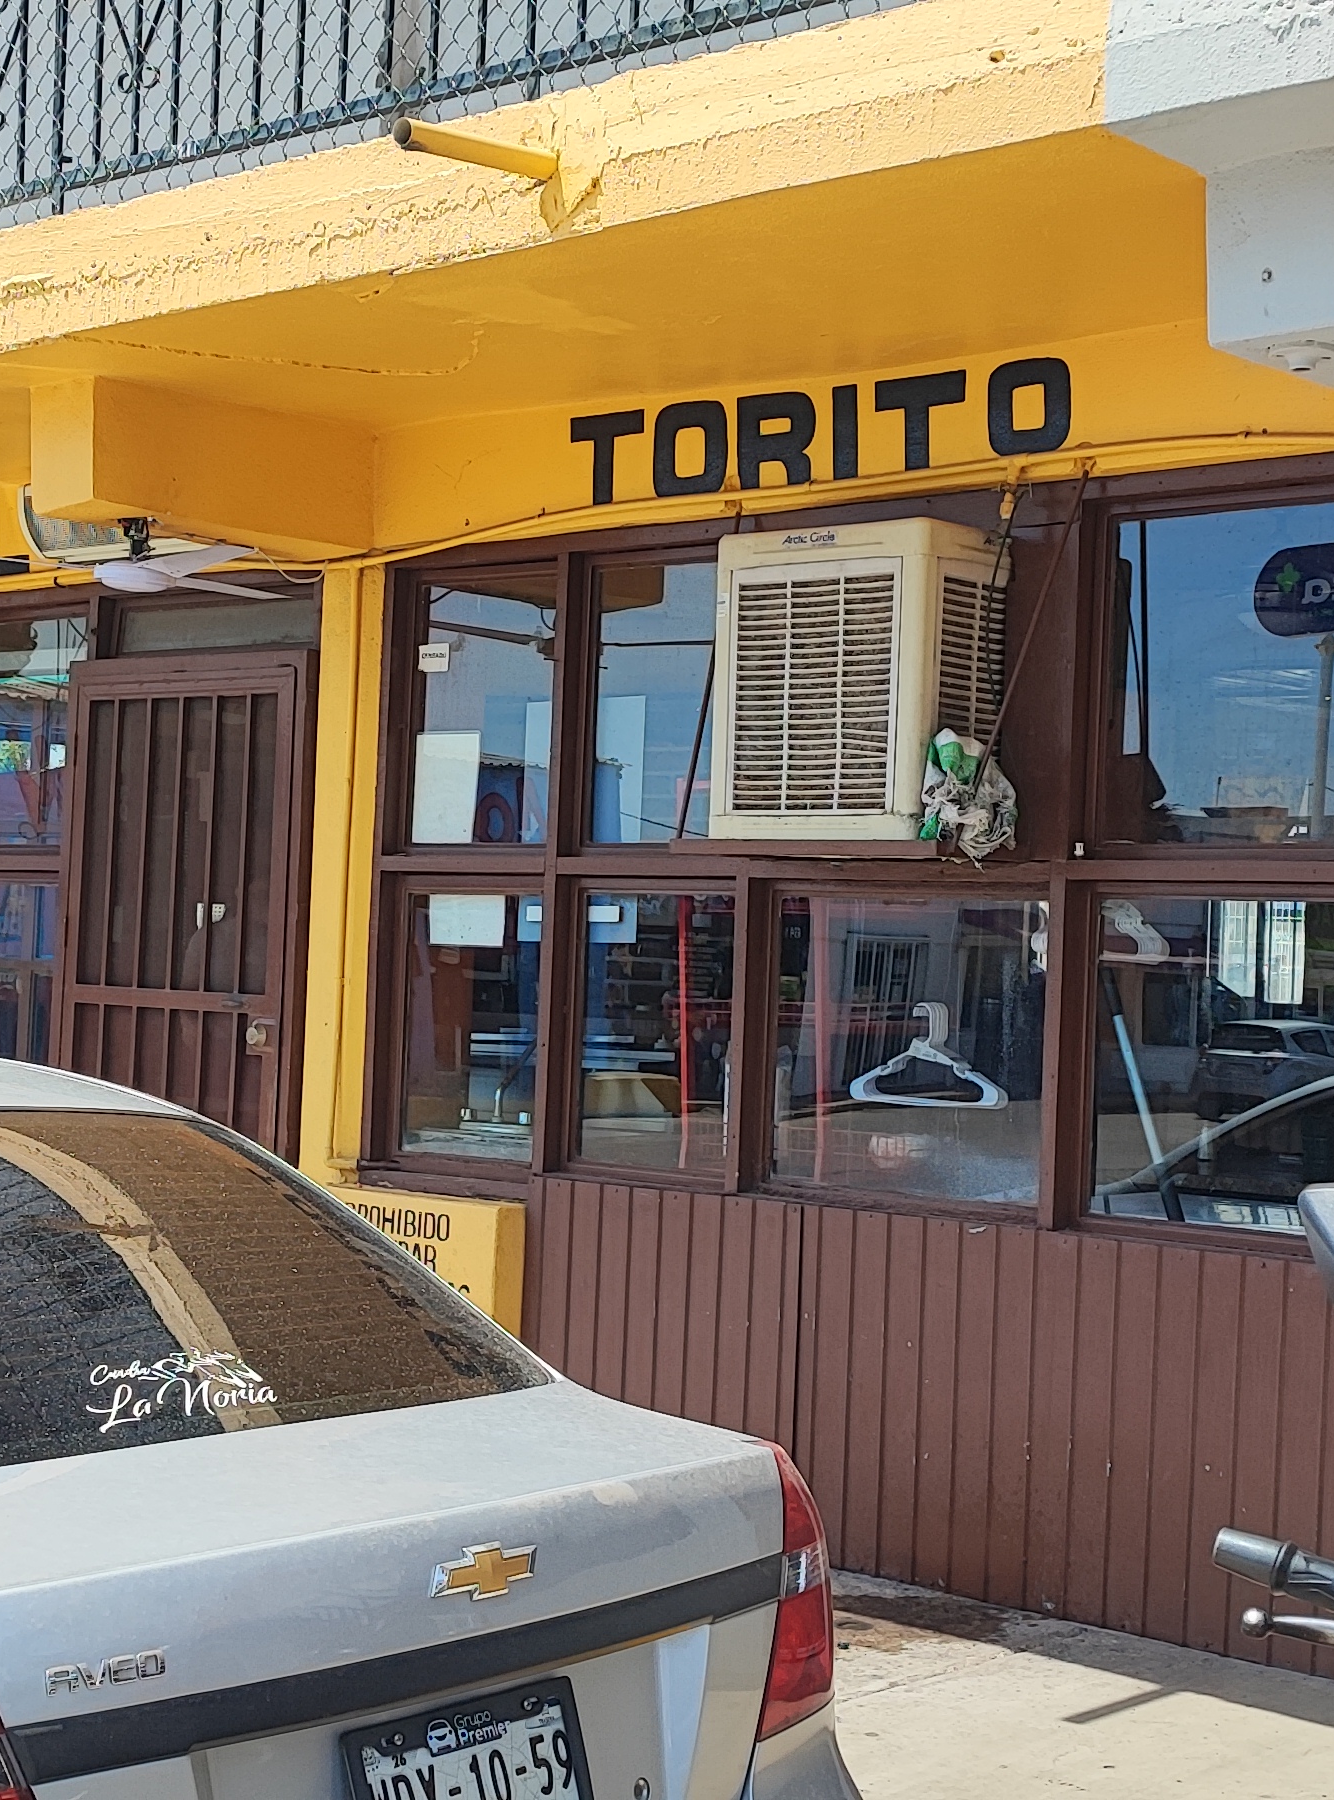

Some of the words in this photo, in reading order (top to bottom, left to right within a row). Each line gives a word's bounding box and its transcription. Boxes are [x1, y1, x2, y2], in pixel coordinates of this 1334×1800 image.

[570, 357, 1071, 504] TORITO
[86, 1383, 152, 1434] La
[157, 1377, 278, 1417] Noria
[45, 1649, 166, 1697] AVEO
[453, 1709, 492, 1729] Grupo
[457, 1719, 511, 1746] Premier
